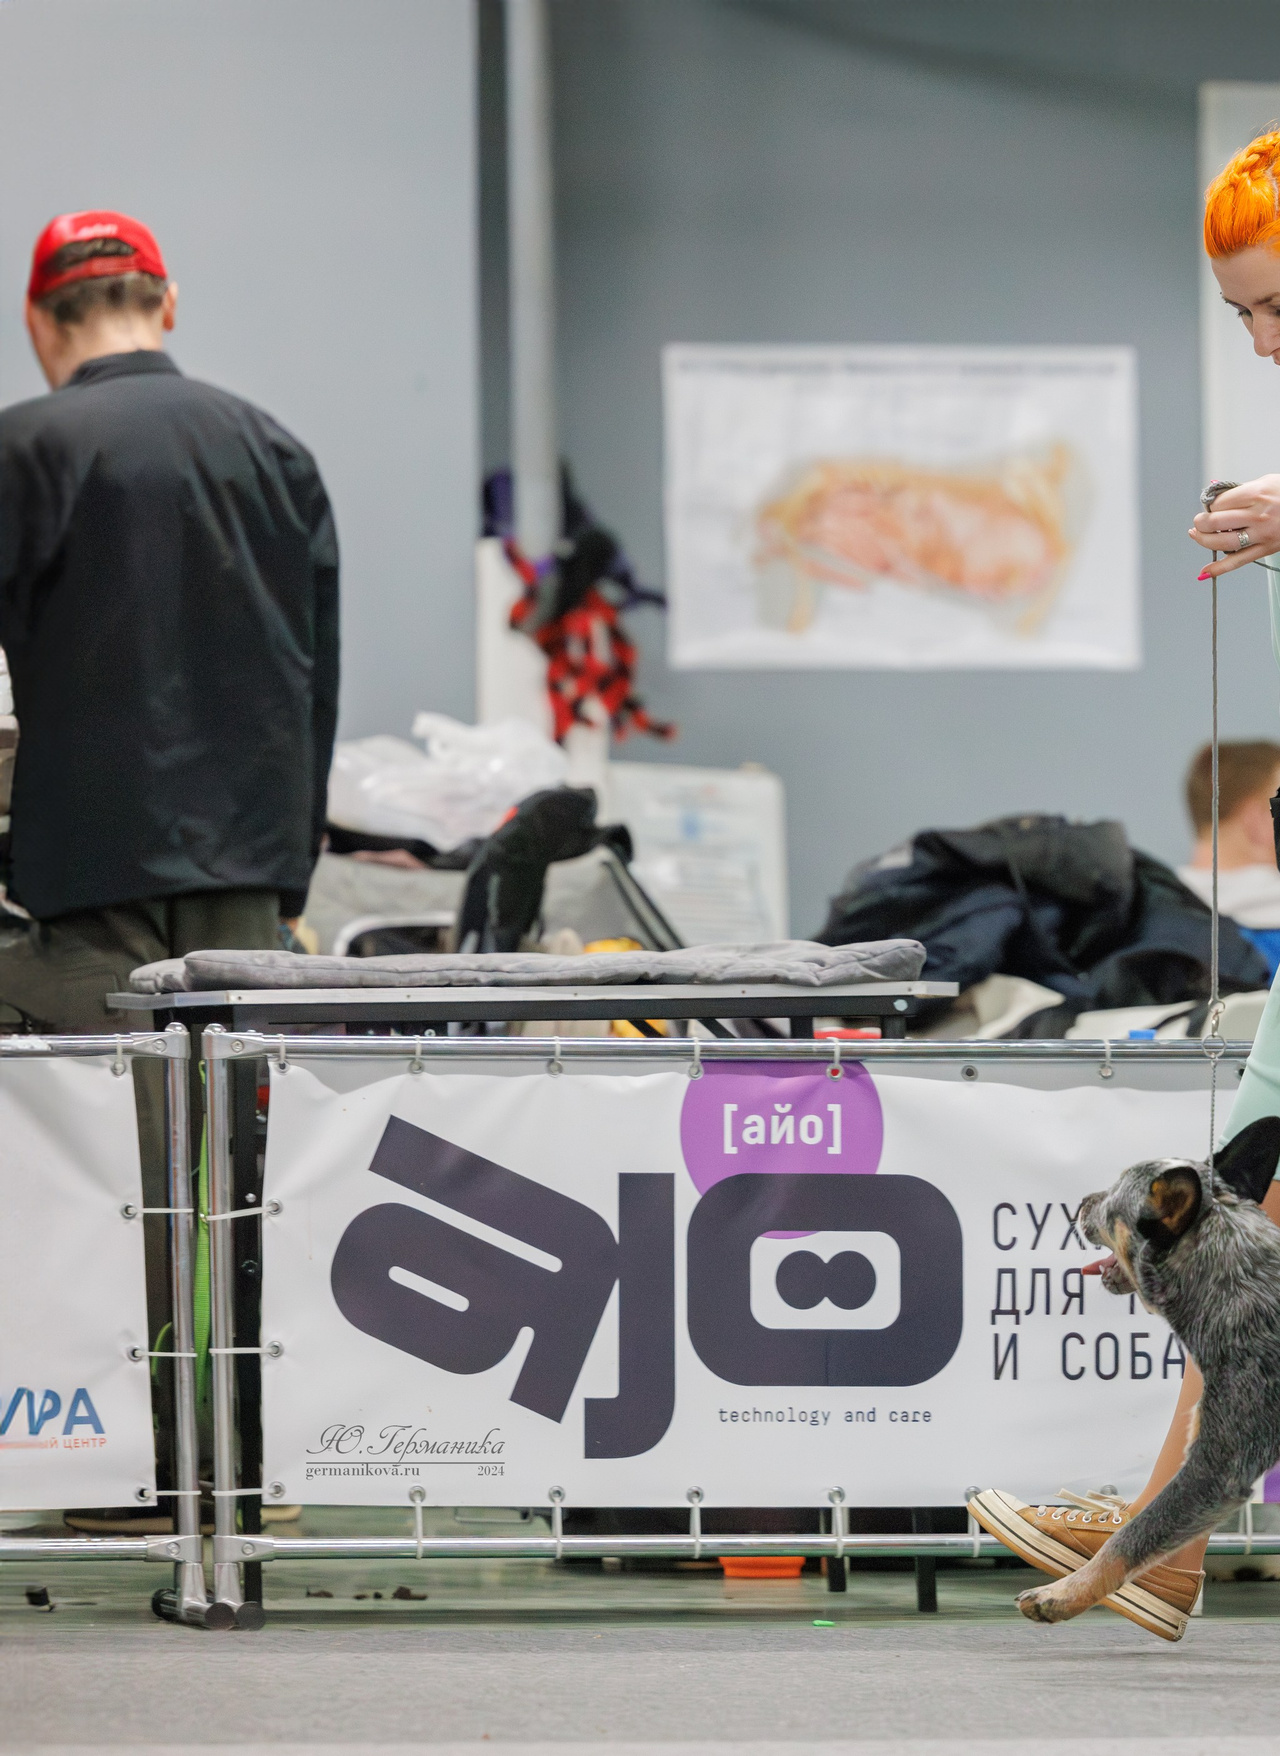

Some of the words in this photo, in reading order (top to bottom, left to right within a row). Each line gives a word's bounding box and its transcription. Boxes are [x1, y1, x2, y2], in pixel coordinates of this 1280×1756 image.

[723, 1103, 842, 1154] [айо]
[993, 1202, 1098, 1250] СУХ
[991, 1268, 1084, 1325] ДЛЯ
[994, 1332, 1018, 1380] И
[1062, 1332, 1186, 1380] СОБА
[718, 1407, 831, 1426] technology
[844, 1407, 877, 1423] and
[889, 1410, 932, 1423] care
[63, 1437, 107, 1450] ЦЕНТР
